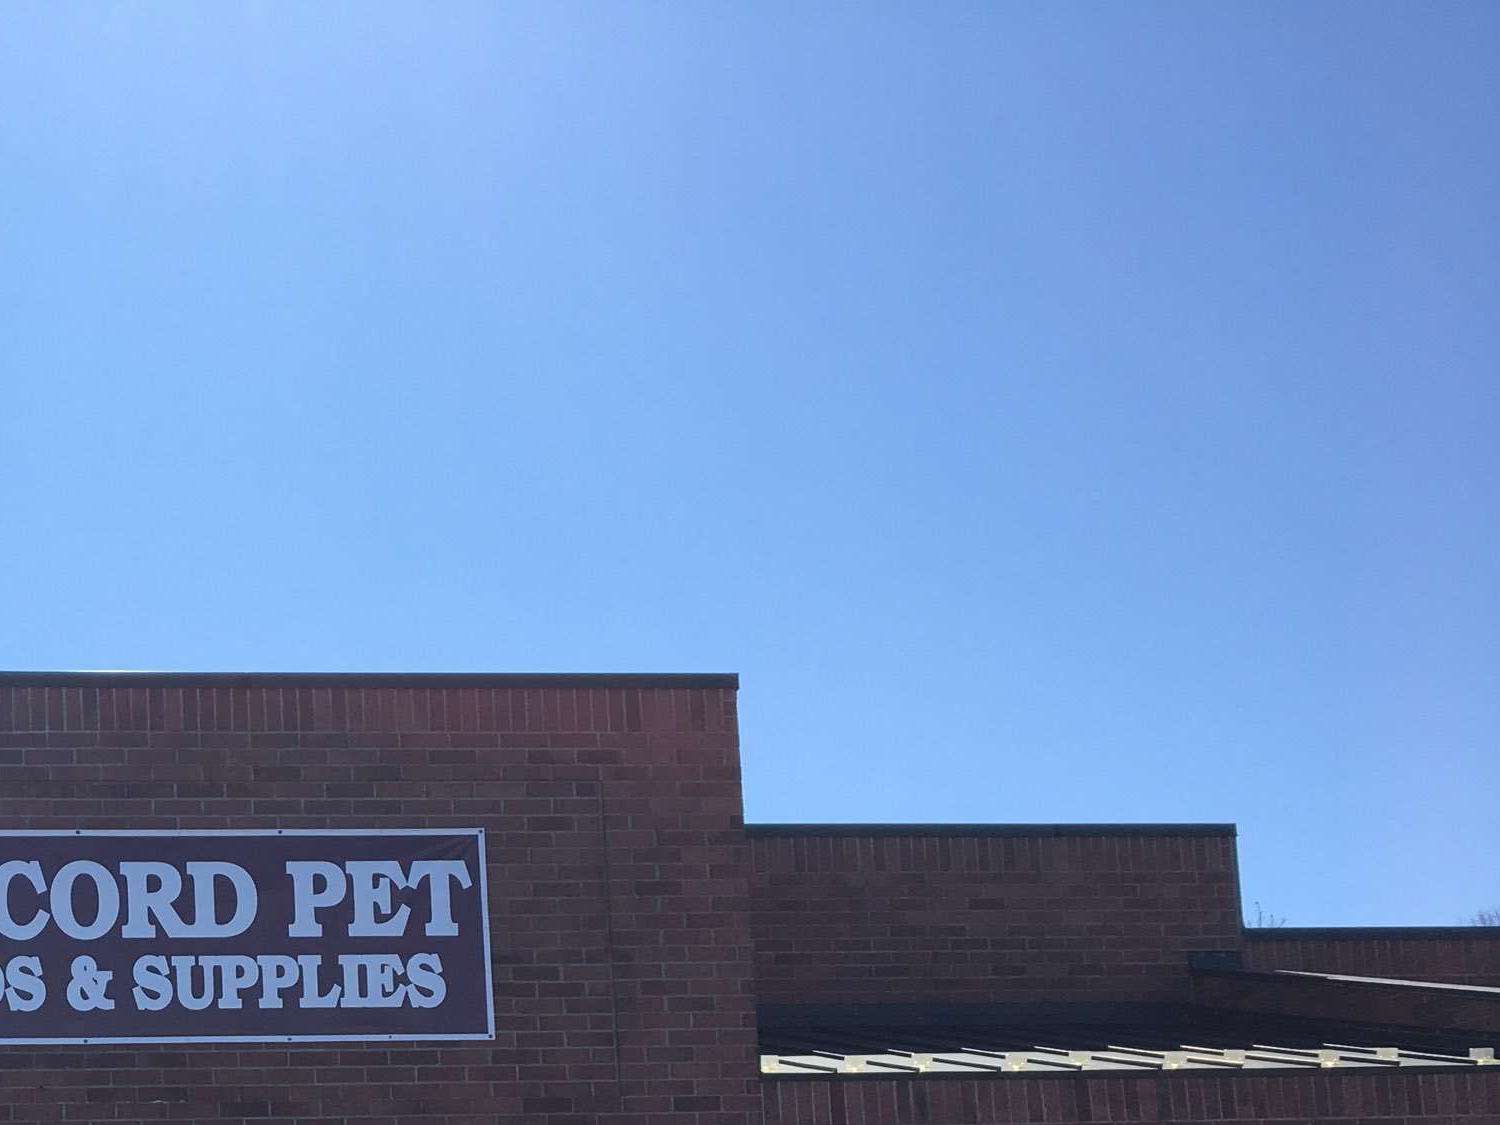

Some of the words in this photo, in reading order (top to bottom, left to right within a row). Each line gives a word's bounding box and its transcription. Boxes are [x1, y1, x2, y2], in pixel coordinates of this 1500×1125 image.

[285, 859, 473, 937] PET
[66, 954, 116, 1012] &
[132, 952, 447, 1011] SUPPLIES
